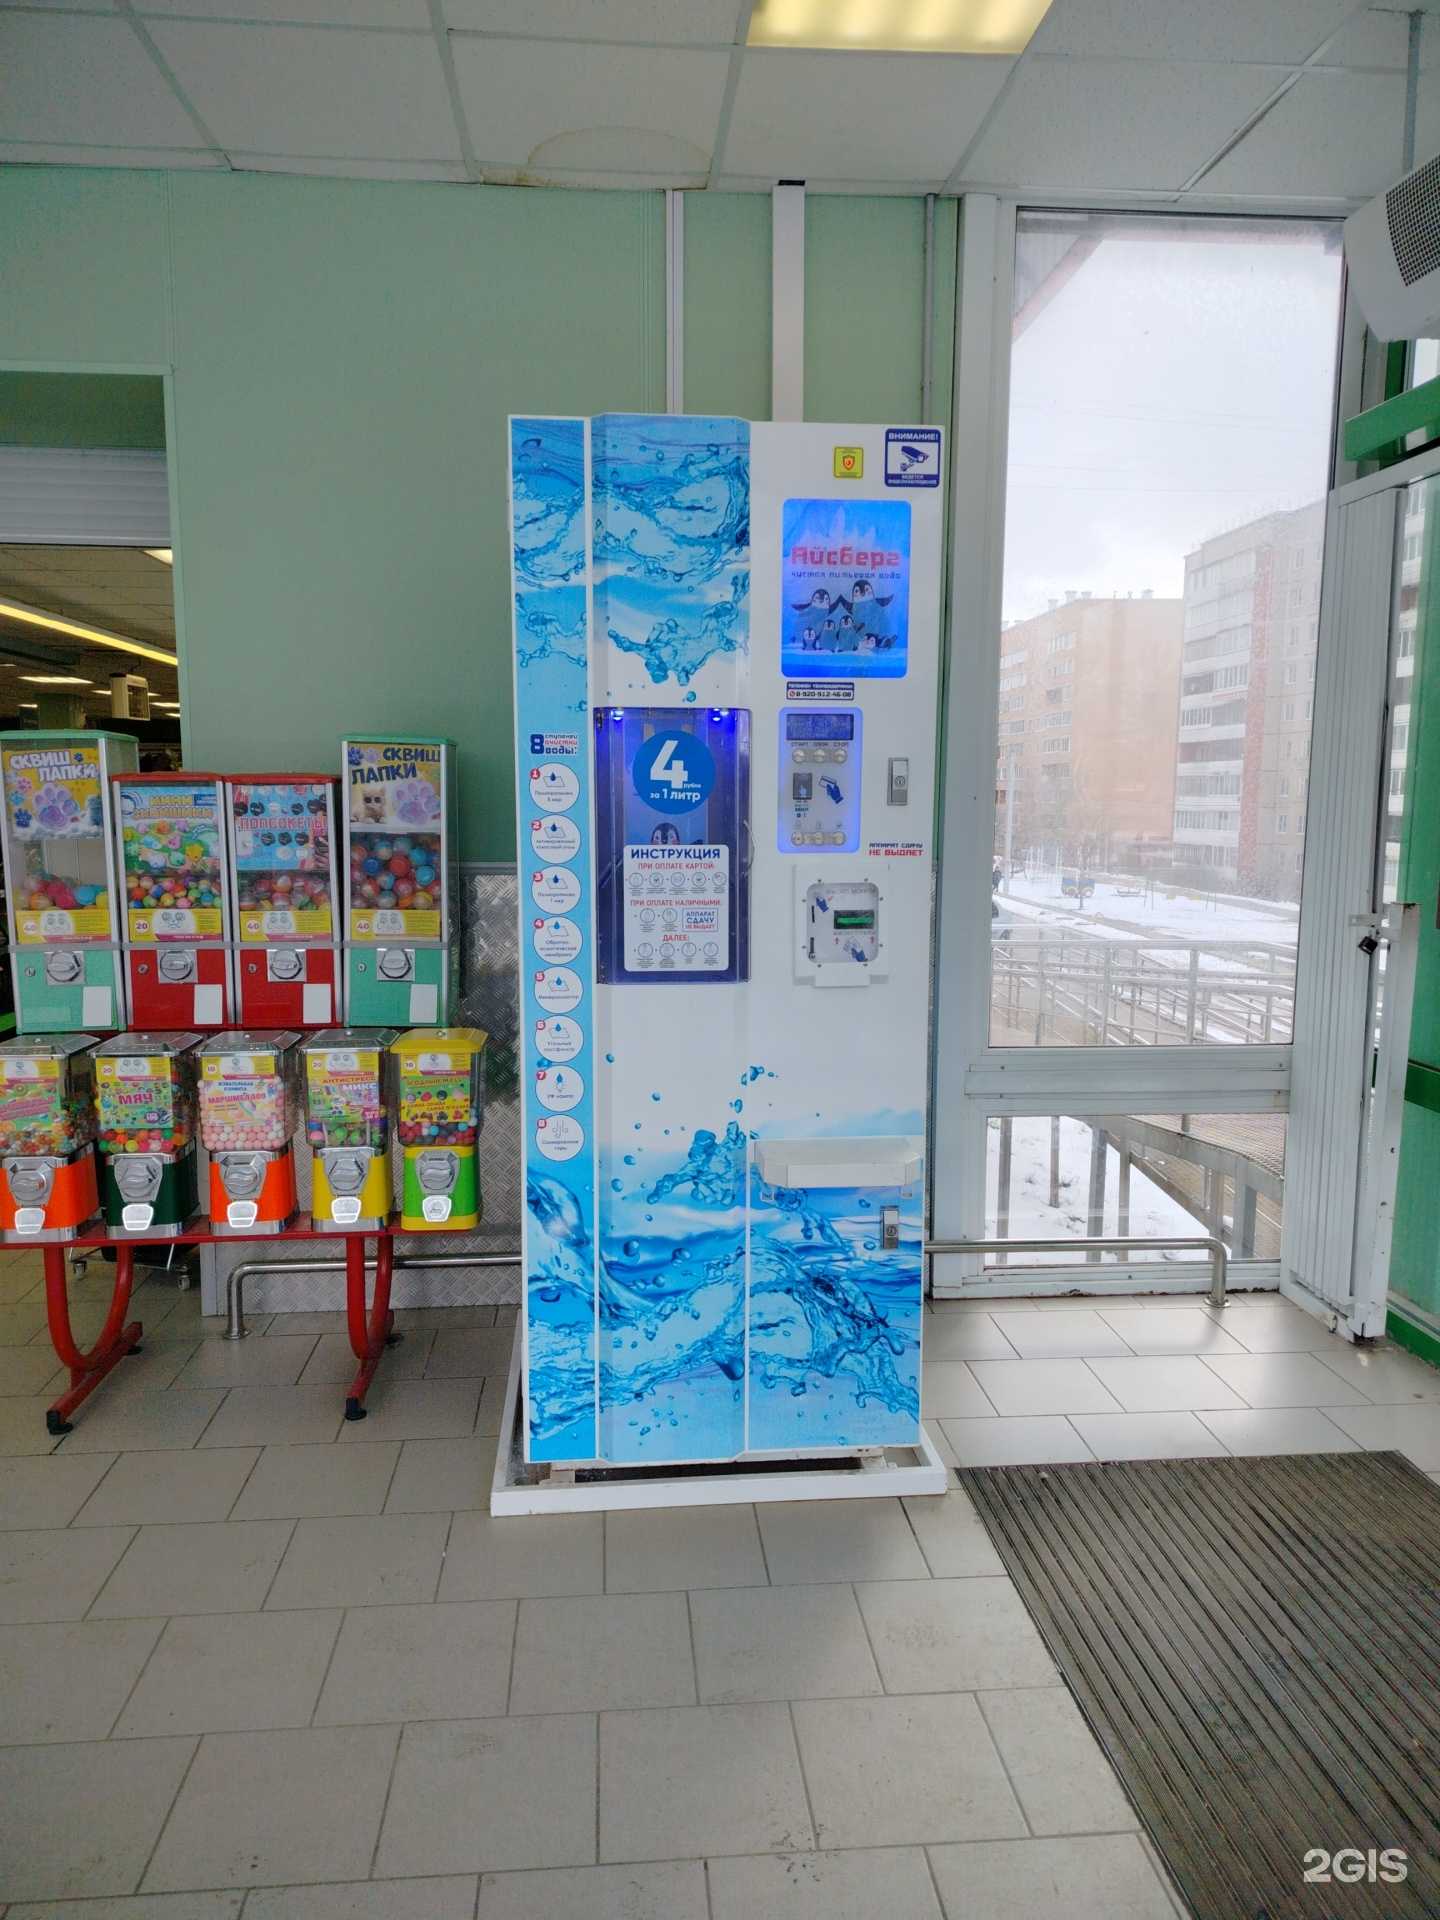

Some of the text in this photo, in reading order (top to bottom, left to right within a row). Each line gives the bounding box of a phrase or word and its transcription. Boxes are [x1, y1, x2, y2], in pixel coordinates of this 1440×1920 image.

[888, 432, 939, 441] ВНИМАНИЕ!
[791, 545, 900, 570] Айсберг
[530, 734, 544, 754] 8
[545, 745, 577, 755] воды:
[10, 751, 71, 770] СКВИШ
[382, 746, 440, 763] СКВИШ
[650, 740, 688, 789] 4
[38, 763, 99, 782] ПАПКИ
[350, 763, 418, 784] ПАПКИ
[662, 788, 668, 799] 1
[670, 791, 701, 803] литр
[631, 848, 721, 860] ИНСТРУКЦИЯ
[868, 849, 881, 857] НЕ
[630, 899, 645, 907] ПРИ
[646, 899, 673, 907] ОПЛАТЕ
[135, 922, 148, 930] 20
[246, 922, 260, 931] 40
[356, 922, 370, 931] 40
[118, 1093, 153, 1105] МЯЧ
